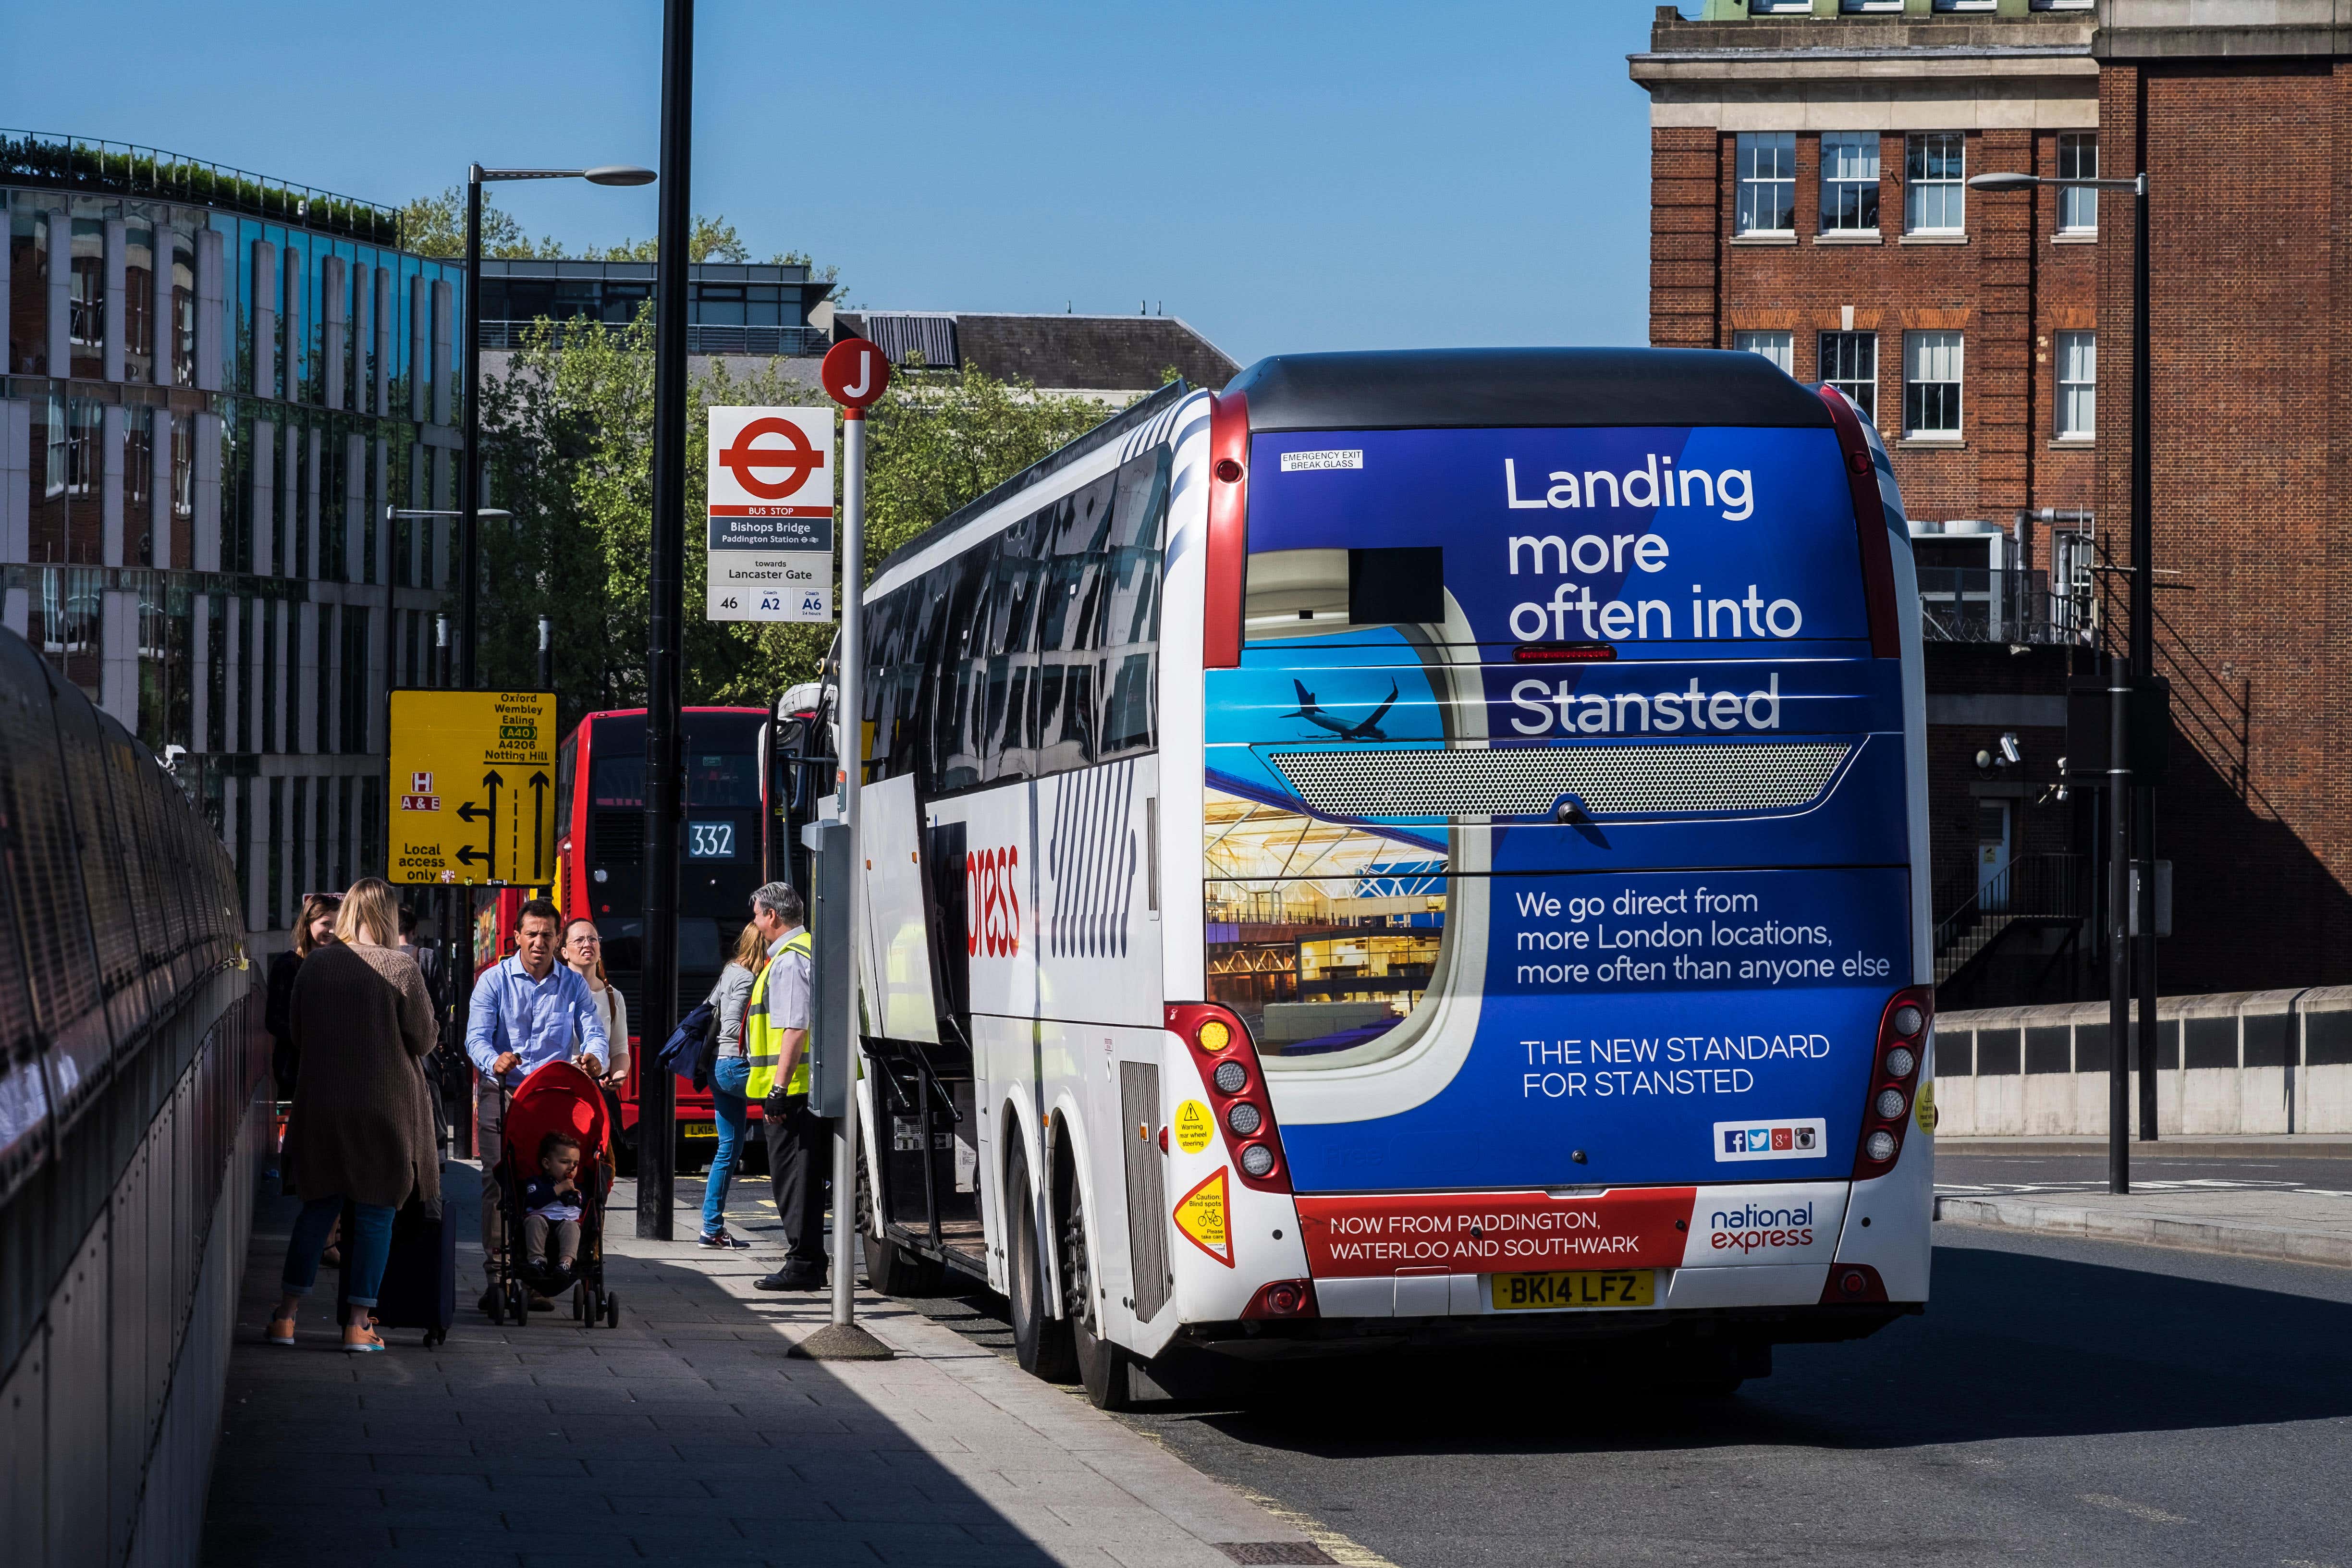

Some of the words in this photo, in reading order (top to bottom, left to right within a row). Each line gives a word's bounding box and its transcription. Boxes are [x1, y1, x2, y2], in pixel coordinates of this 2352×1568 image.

[843, 351, 870, 398] J
[1283, 452, 1339, 461] EMERGENCY
[1291, 461, 1321, 469] BREAK
[1323, 460, 1353, 468] GLASS
[1505, 453, 1753, 521] Landing
[731, 522, 773, 533] Bishops
[776, 523, 811, 534] Bridge
[722, 535, 768, 544] Paddington
[1509, 533, 1669, 575] more
[729, 570, 783, 579] Lancaster
[786, 570, 812, 579] Gate
[720, 597, 738, 609] 46
[760, 598, 780, 610] A2
[802, 598, 821, 610] A6
[1509, 583, 1672, 641] often
[1692, 585, 1802, 638] into
[501, 693, 537, 703] Oxford
[1511, 673, 1780, 735] Stansted
[495, 704, 543, 715] Wembley
[502, 715, 534, 725] Ealing
[500, 727, 537, 738] (A40)
[498, 740, 536, 749] A4206
[485, 750, 525, 761] Notting
[529, 752, 548, 760] Hill
[414, 773, 430, 792] H
[402, 798, 411, 809] A
[416, 798, 426, 809] &
[431, 798, 440, 809] E
[691, 824, 732, 856] 332
[404, 843, 441, 855] Local
[399, 858, 445, 867] access
[407, 869, 436, 882] only
[1516, 891, 1560, 918] We
[1569, 895, 1604, 922] go
[1613, 889, 1687, 915] direct
[1694, 887, 1758, 913] from
[1517, 929, 1589, 950] more
[1599, 921, 1702, 949] London
[1711, 920, 1832, 947] locations,
[1517, 962, 1589, 984] more
[1597, 956, 1666, 981] often
[1674, 954, 1730, 980] than
[1740, 957, 1835, 985] anyone
[1841, 951, 1890, 977] else
[1520, 1040, 1582, 1065] THE
[1591, 1038, 1659, 1063] NEW
[1666, 1034, 1830, 1062] STANDARD
[1524, 1072, 1587, 1098] FOR
[1595, 1068, 1754, 1096] STANSTED
[1711, 1201, 1813, 1229] national
[1331, 1217, 1383, 1234] NOW
[1389, 1215, 1451, 1233] FROM
[1458, 1212, 1600, 1231] PADDINGTON,
[1711, 1225, 1813, 1255] express
[1329, 1241, 1449, 1259] WATERLOO
[1453, 1240, 1499, 1257] AND
[1504, 1236, 1639, 1256] SOUTHWARK
[1511, 1276, 1572, 1303] BK14
[1582, 1276, 1636, 1302] LFZ
